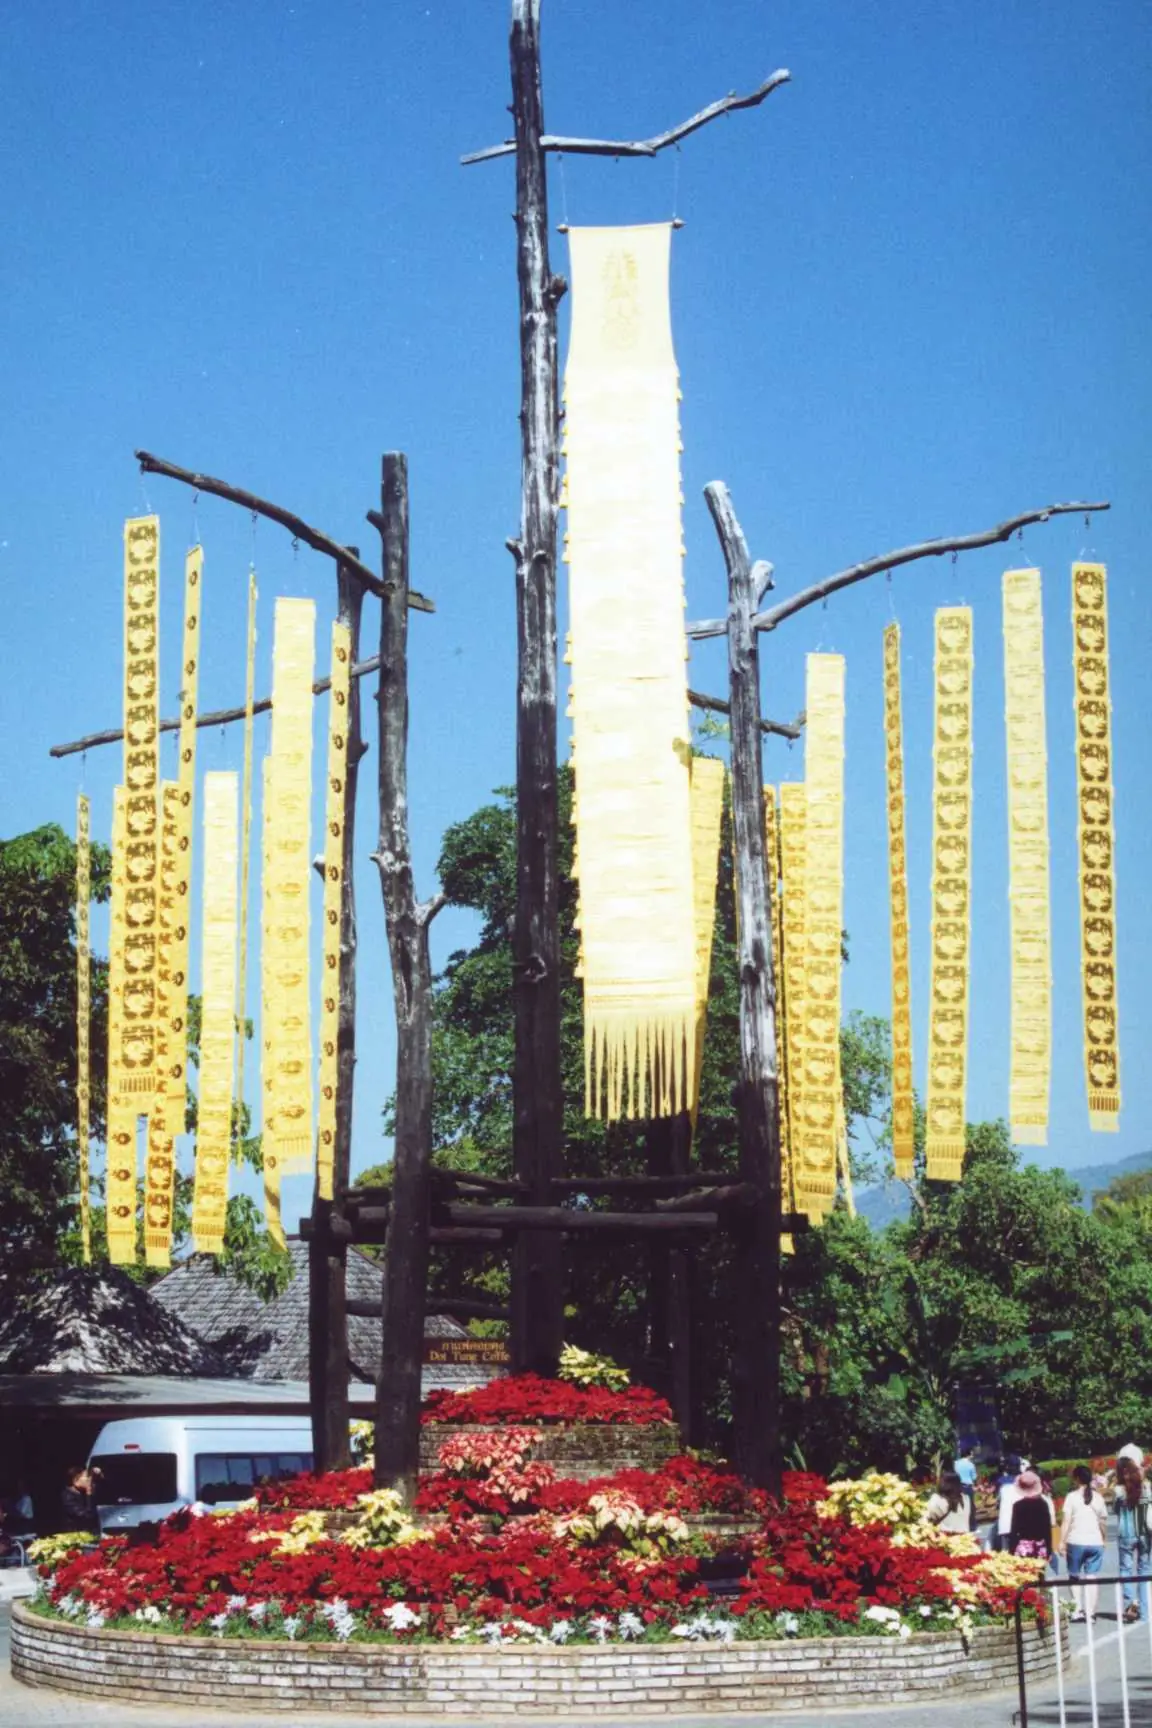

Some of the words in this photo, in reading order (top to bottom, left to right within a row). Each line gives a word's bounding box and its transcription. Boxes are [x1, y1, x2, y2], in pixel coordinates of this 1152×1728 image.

[430, 1350, 446, 1361] Doi
[453, 1351, 477, 1362] Tung
[482, 1350, 511, 1361] Coffe
